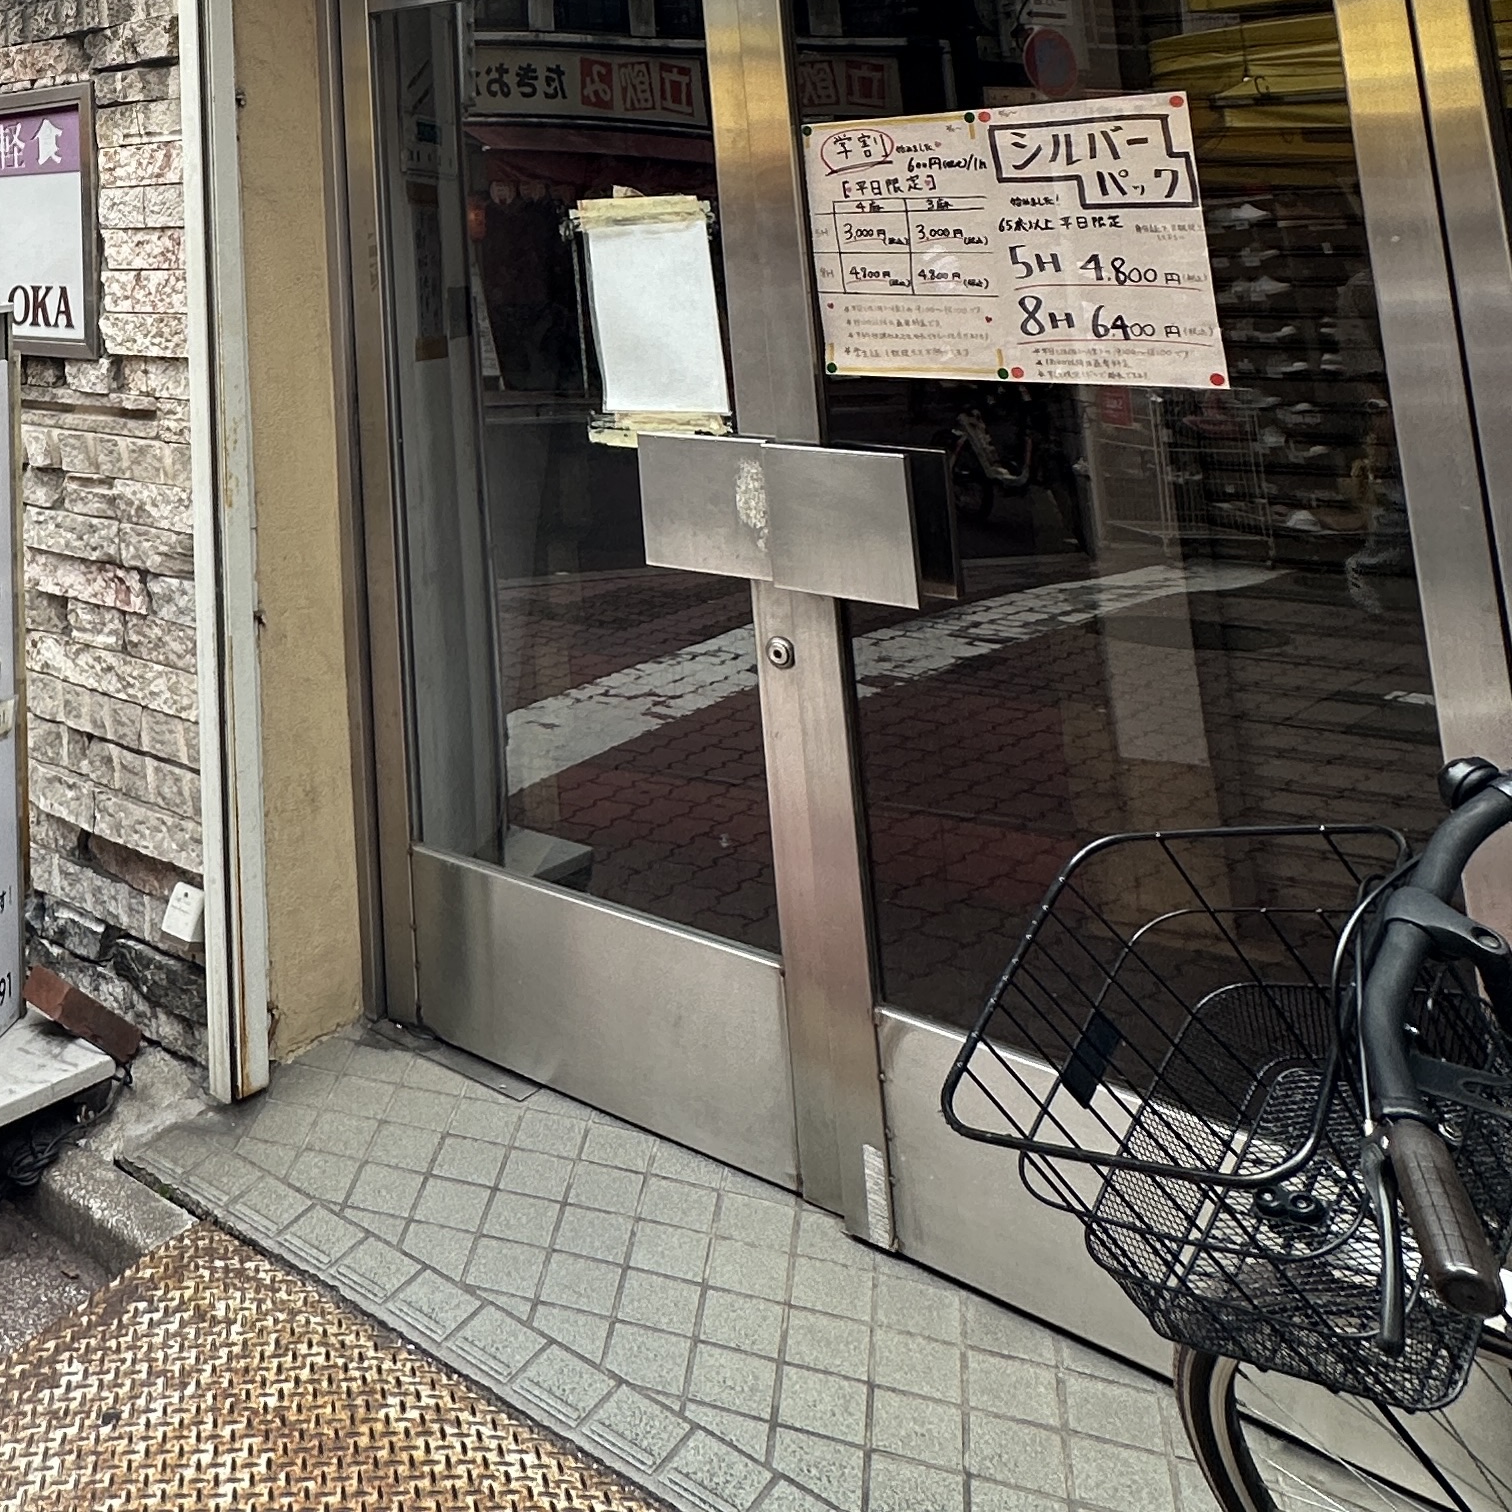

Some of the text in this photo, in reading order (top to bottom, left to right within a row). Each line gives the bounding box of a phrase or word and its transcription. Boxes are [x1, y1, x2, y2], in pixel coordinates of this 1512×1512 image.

[833, 133, 888, 159] 学割
[1010, 125, 1149, 170] シルバー
[1097, 168, 1180, 198] パック
[1008, 244, 1062, 279] 5H
[8, 285, 75, 329] OKA
[1018, 295, 1075, 336] 8H
